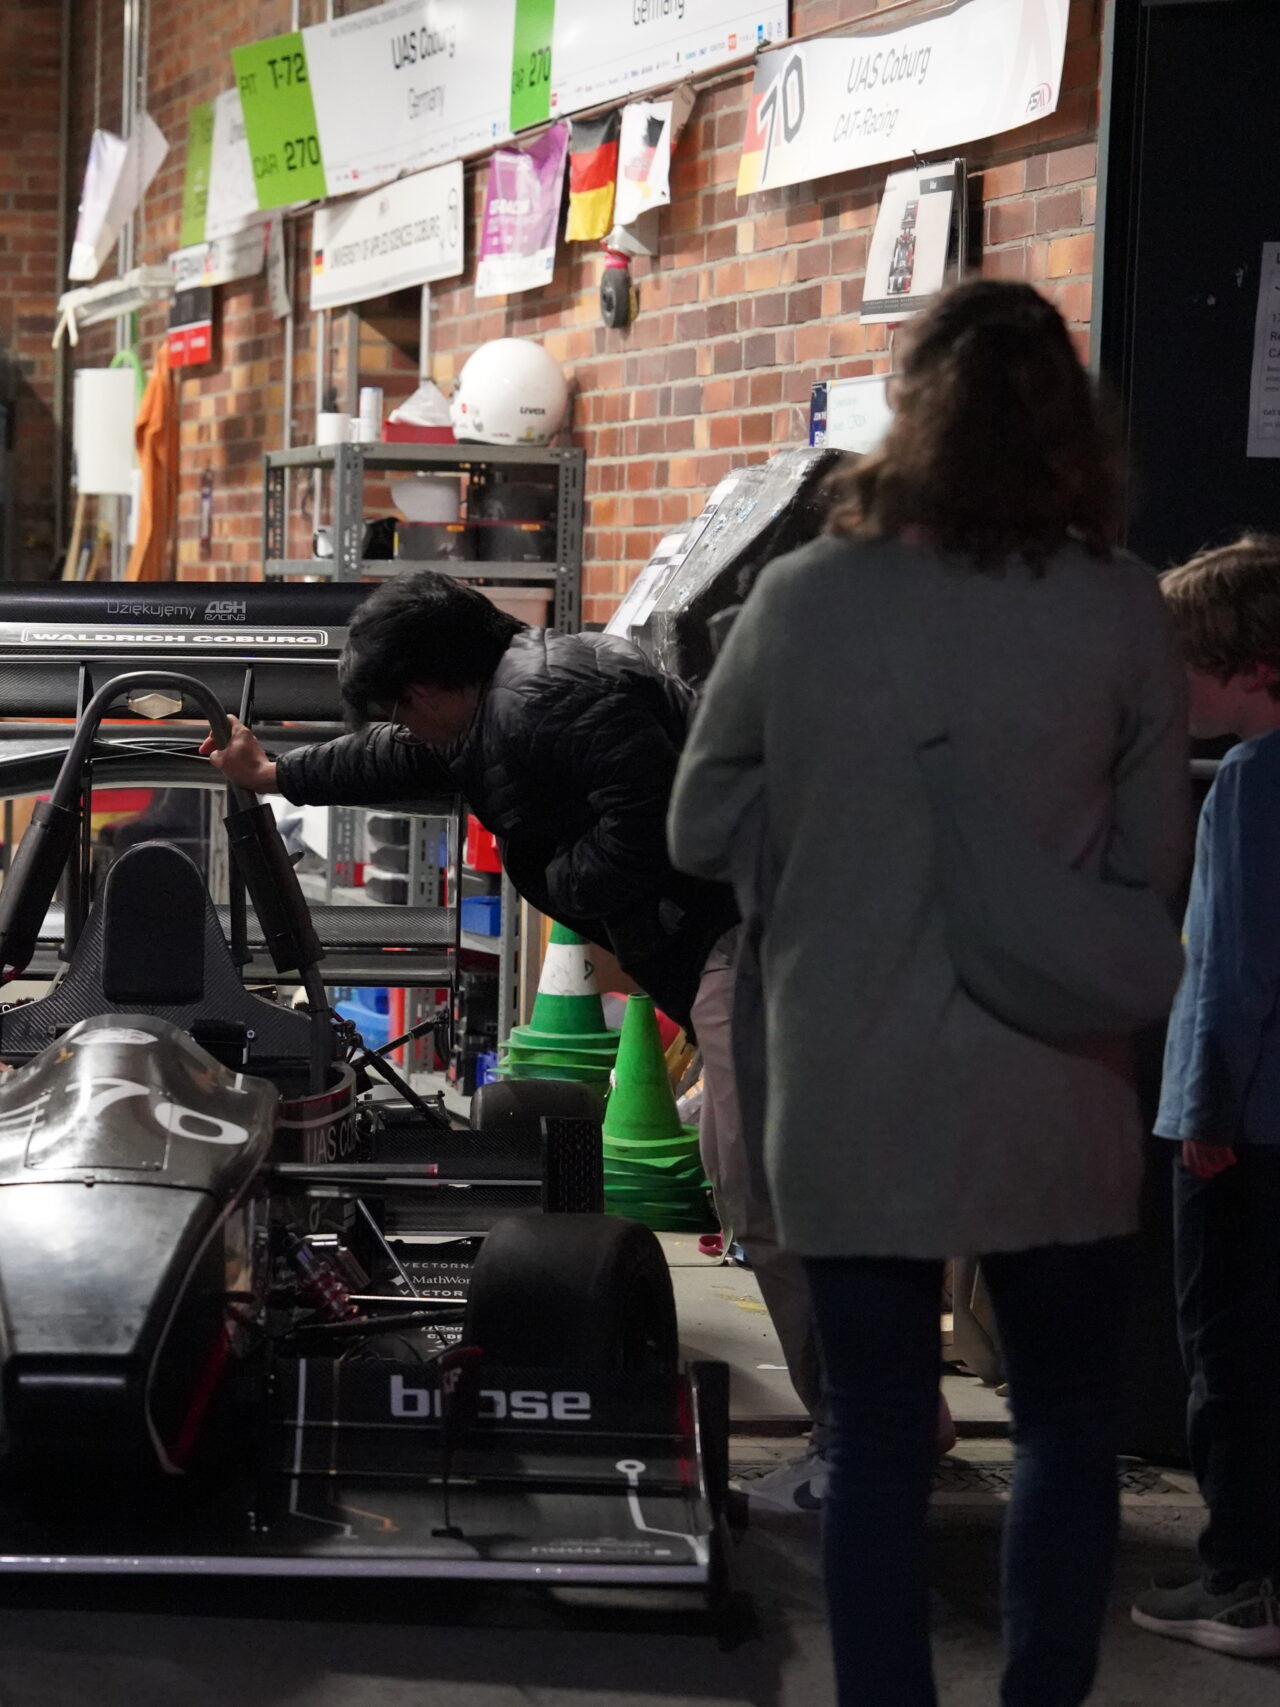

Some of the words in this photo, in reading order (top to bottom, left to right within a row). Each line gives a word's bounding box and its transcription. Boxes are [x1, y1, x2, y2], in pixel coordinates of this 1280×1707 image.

[390, 30, 418, 70] UAS
[419, 26, 456, 60] Coburg
[529, 46, 552, 88] 270
[267, 52, 307, 89] T-72
[846, 52, 880, 95] UAS
[880, 45, 932, 86] Coburg
[407, 84, 447, 119] Germany
[757, 50, 806, 184] 70
[832, 103, 900, 142] CAT-Racing
[253, 153, 279, 180] CAR
[284, 135, 321, 171] 270
[107, 601, 197, 619] Dziękujemy
[32, 633, 185, 643] WALDRICH
[193, 635, 318, 644] COBURG
[400, 1289, 464, 1297] VCTOR
